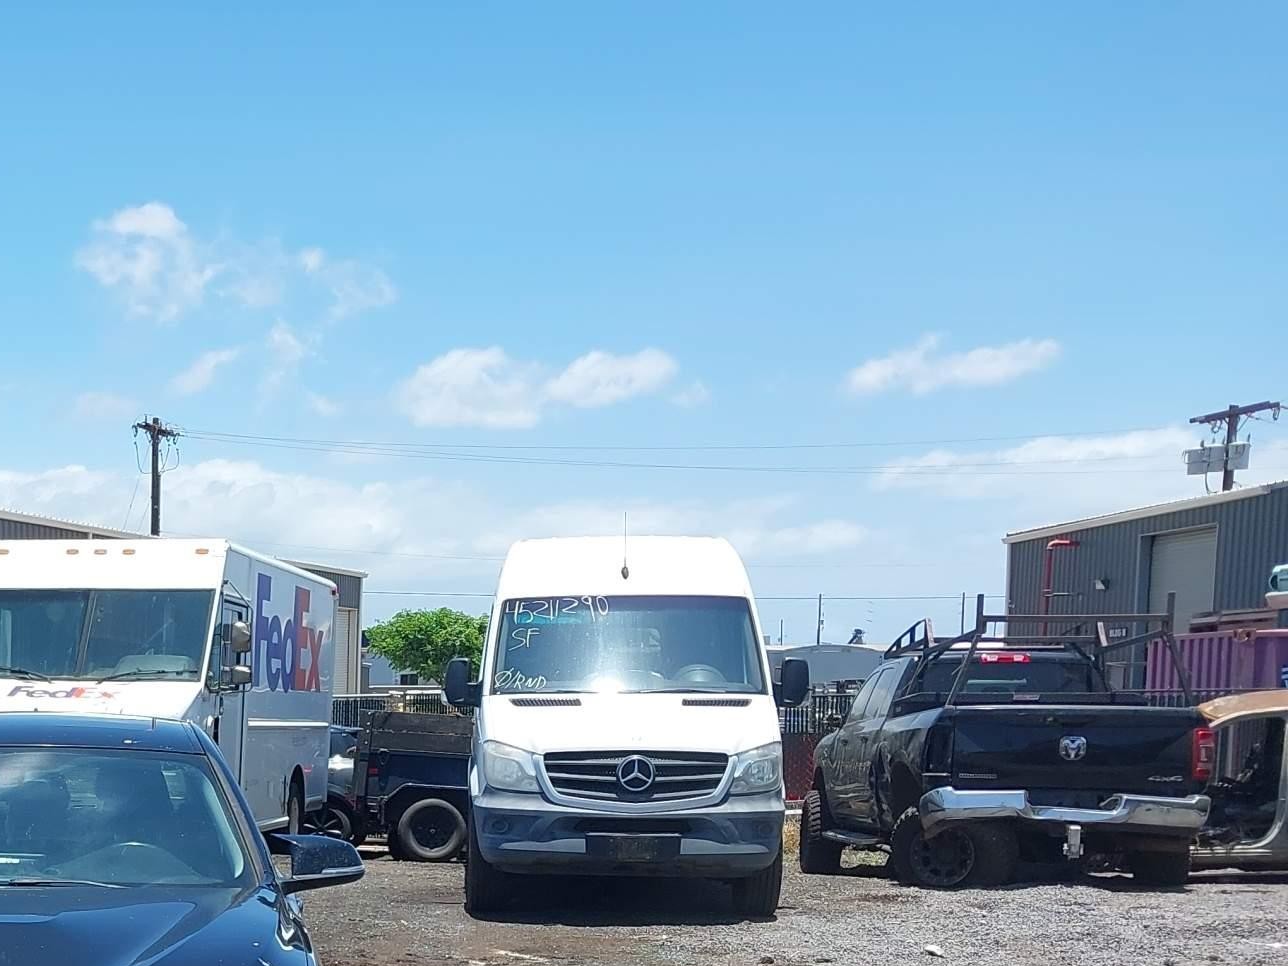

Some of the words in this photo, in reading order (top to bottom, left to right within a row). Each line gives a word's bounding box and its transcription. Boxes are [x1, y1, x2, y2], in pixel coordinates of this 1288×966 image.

[253, 572, 324, 693] FedEx
[508, 627, 541, 651] SF
[7, 685, 121, 700] FedEx
